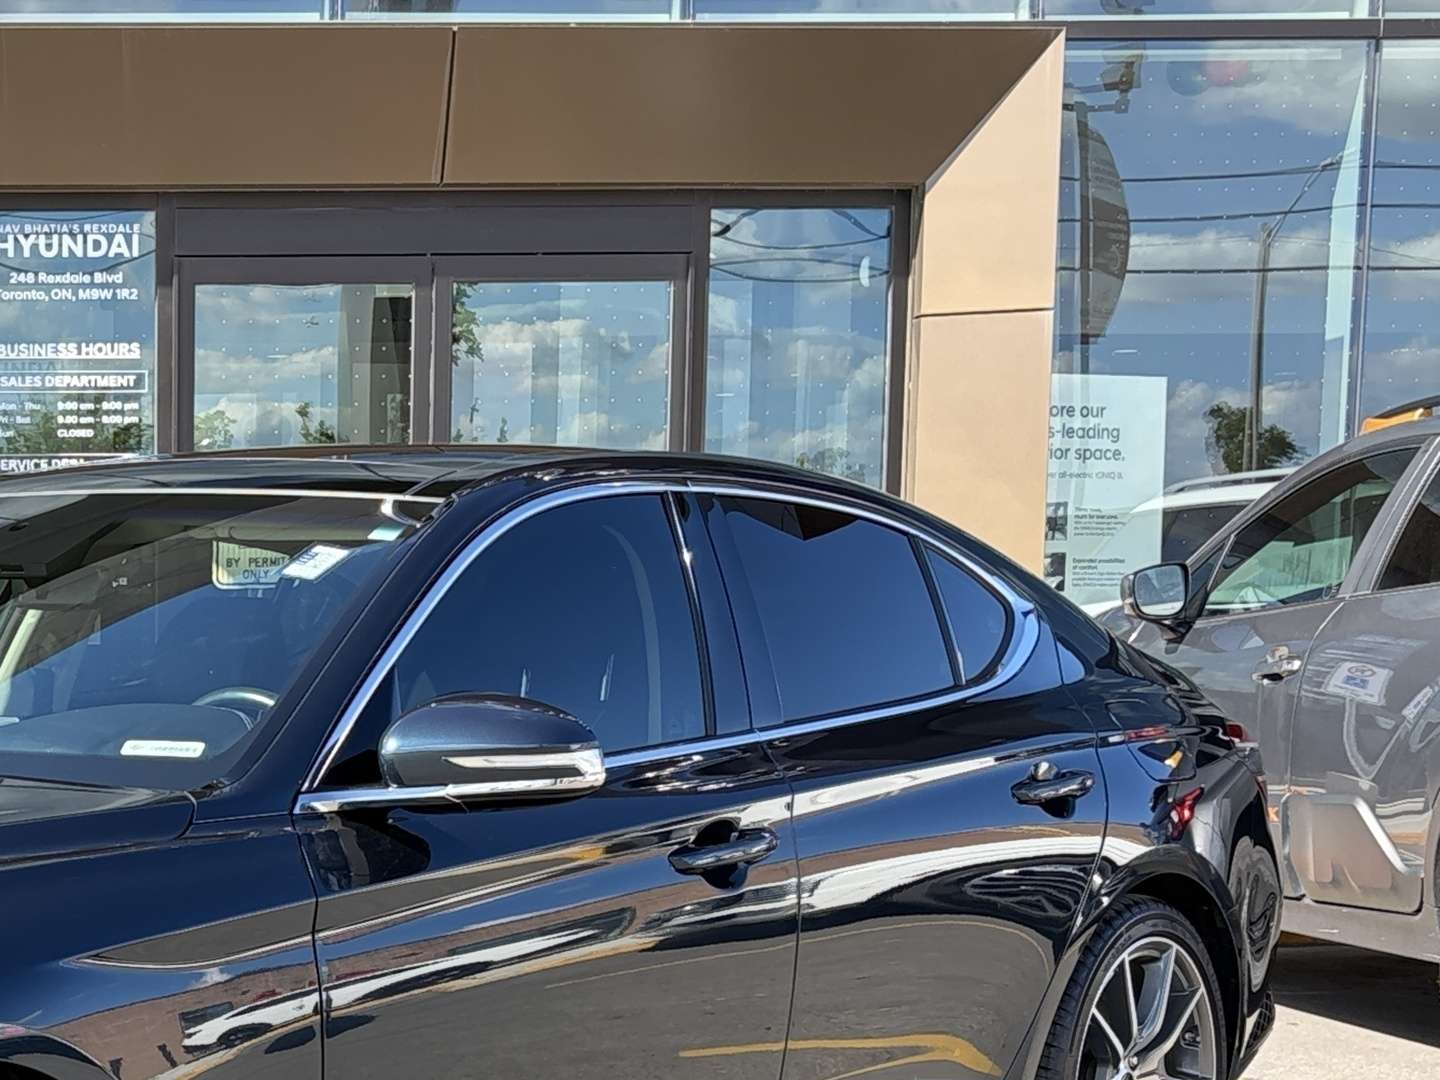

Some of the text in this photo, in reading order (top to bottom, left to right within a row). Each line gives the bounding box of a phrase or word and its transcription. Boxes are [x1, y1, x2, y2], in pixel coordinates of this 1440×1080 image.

[24, 223, 80, 234] BHATIA'S
[83, 223, 140, 233] REXDALE
[9, 271, 123, 284] 248 Rexdale Blvd
[51, 289, 77, 302] ON,
[78, 289, 113, 300] M9W
[115, 288, 138, 300] 1R2
[81, 342, 140, 358] HOURS
[0, 375, 137, 388] SALES DEPARTMENT
[1049, 405, 1107, 418] ore our
[1048, 423, 1120, 443] s-leading
[1049, 443, 1126, 463] ior space.
[226, 557, 241, 569] BY
[248, 557, 287, 568] PERMIT
[242, 569, 269, 579] ONLY
